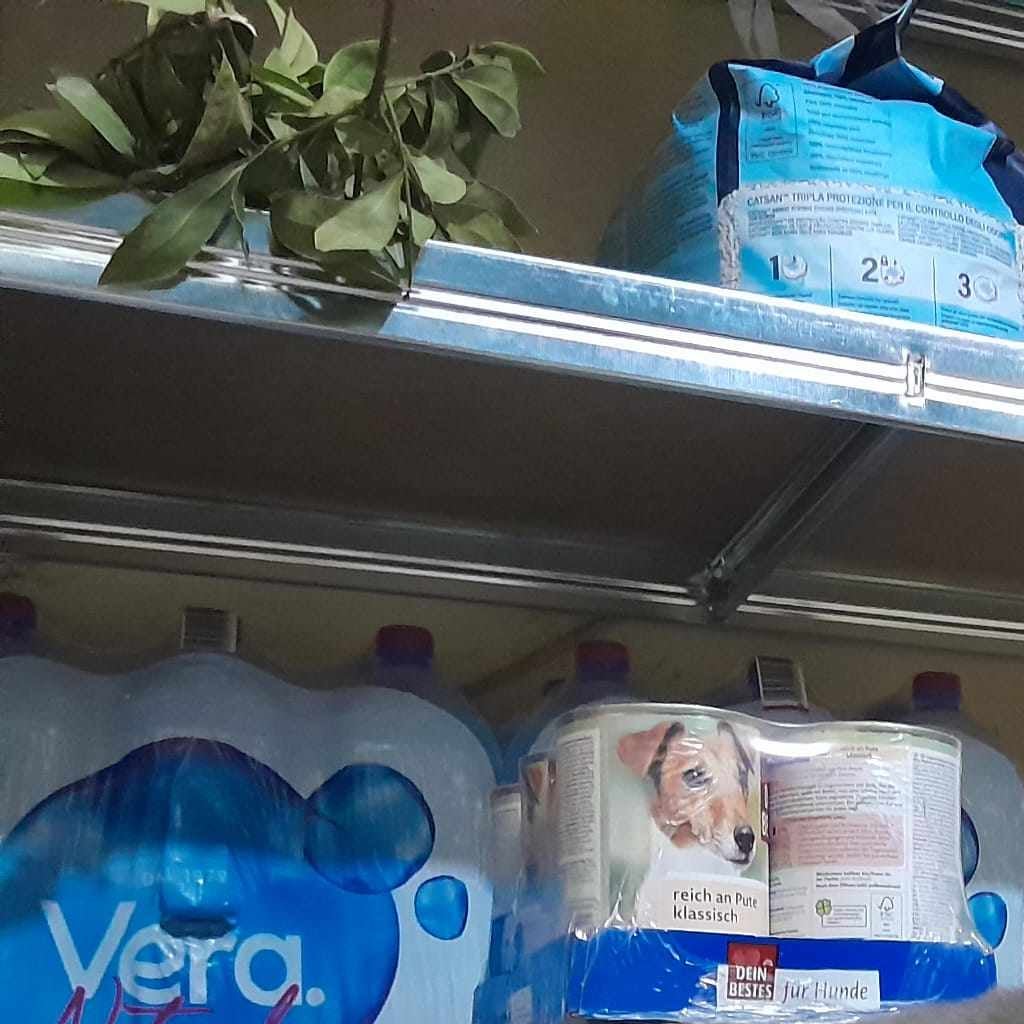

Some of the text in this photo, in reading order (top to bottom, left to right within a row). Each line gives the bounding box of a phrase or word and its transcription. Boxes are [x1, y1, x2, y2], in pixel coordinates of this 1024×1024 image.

[769, 254, 780, 281] 1
[861, 257, 879, 283] 2
[958, 272, 972, 299] 3
[673, 887, 758, 909] reich an Pute
[673, 904, 738, 924] klassisch
[736, 965, 767, 982] DEIN
[728, 982, 773, 999] BESTES
[815, 980, 868, 1001] Hunde
